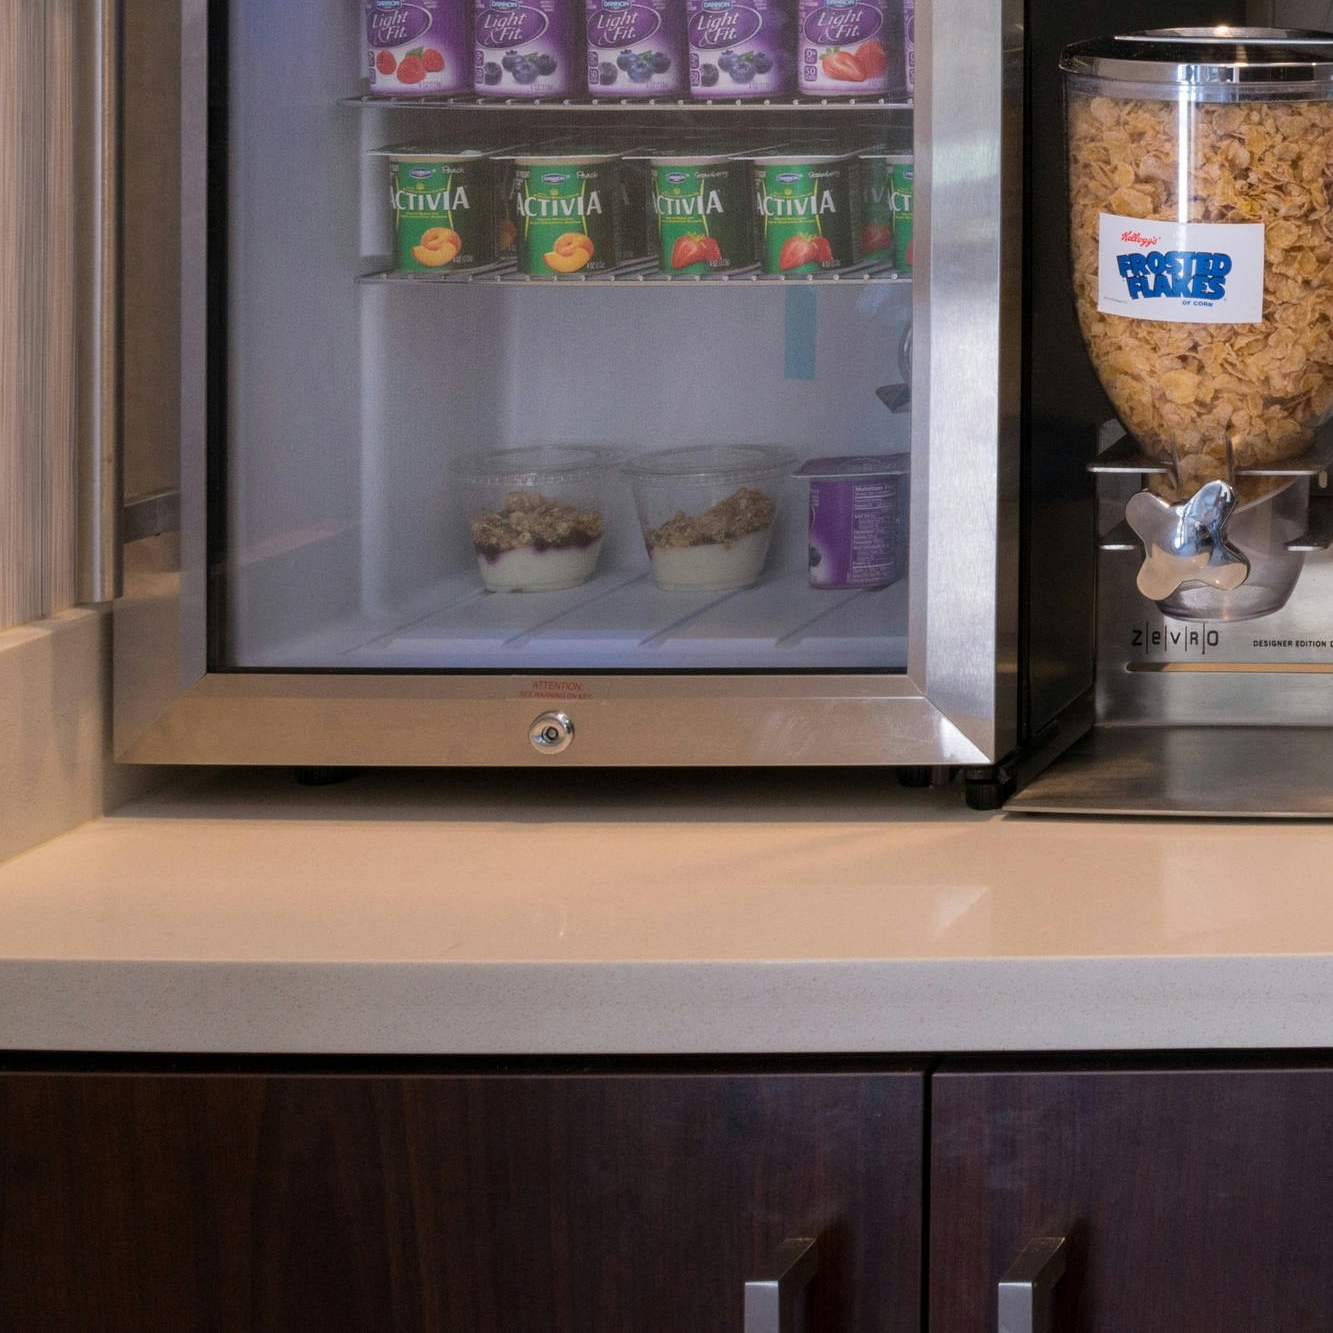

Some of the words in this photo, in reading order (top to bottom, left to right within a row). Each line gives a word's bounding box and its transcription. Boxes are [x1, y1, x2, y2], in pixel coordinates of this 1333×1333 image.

[372, 10, 409, 31] Light
[483, 12, 526, 31] Light
[596, 11, 638, 31] Light
[697, 12, 739, 32] Light
[817, 10, 862, 29] Light
[386, 26, 406, 40] Fit
[499, 27, 521, 41] Fit
[612, 26, 634, 41] Fit
[713, 27, 735, 42] Fit
[835, 25, 857, 39] Fit
[1120, 230, 1159, 248] Kellogg's
[1116, 251, 1232, 278] FROSTED
[1126, 274, 1227, 300] FLAKES
[1253, 640, 1293, 648] DESIGNER
[1295, 640, 1327, 648] EDITION
